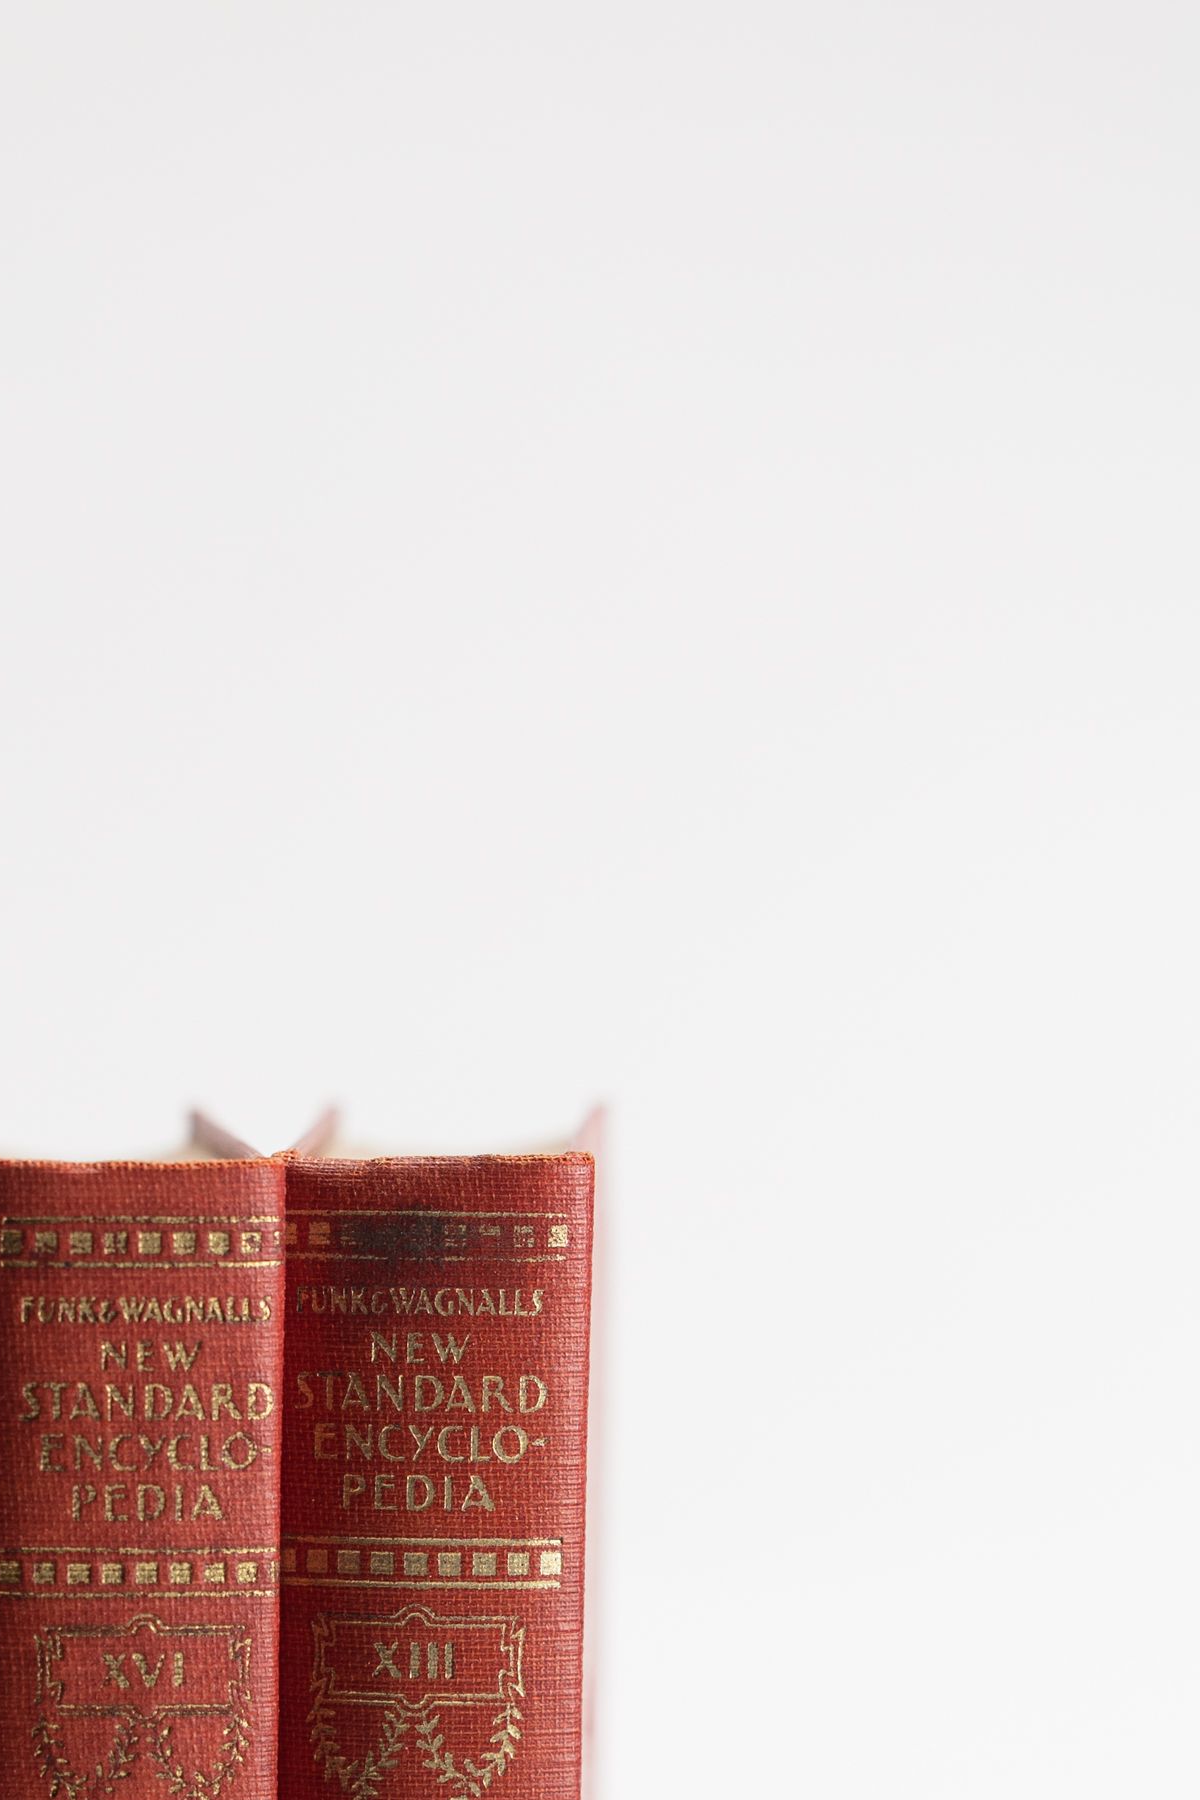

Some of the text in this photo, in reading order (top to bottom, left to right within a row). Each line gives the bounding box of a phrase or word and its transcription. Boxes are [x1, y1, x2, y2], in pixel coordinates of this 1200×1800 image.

[100, 1340, 203, 1373] NEW
[369, 1331, 471, 1366] NEW
[18, 1381, 275, 1423] STANDARD
[295, 1371, 550, 1414] STANDARD
[39, 1430, 272, 1473] ENCYCLO-
[313, 1422, 551, 1465] ENCYCLO-
[71, 1482, 226, 1523] PEDIA
[341, 1473, 498, 1513] PEDIA
[100, 1651, 185, 1690] XVI
[372, 1640, 455, 1680] XIII
